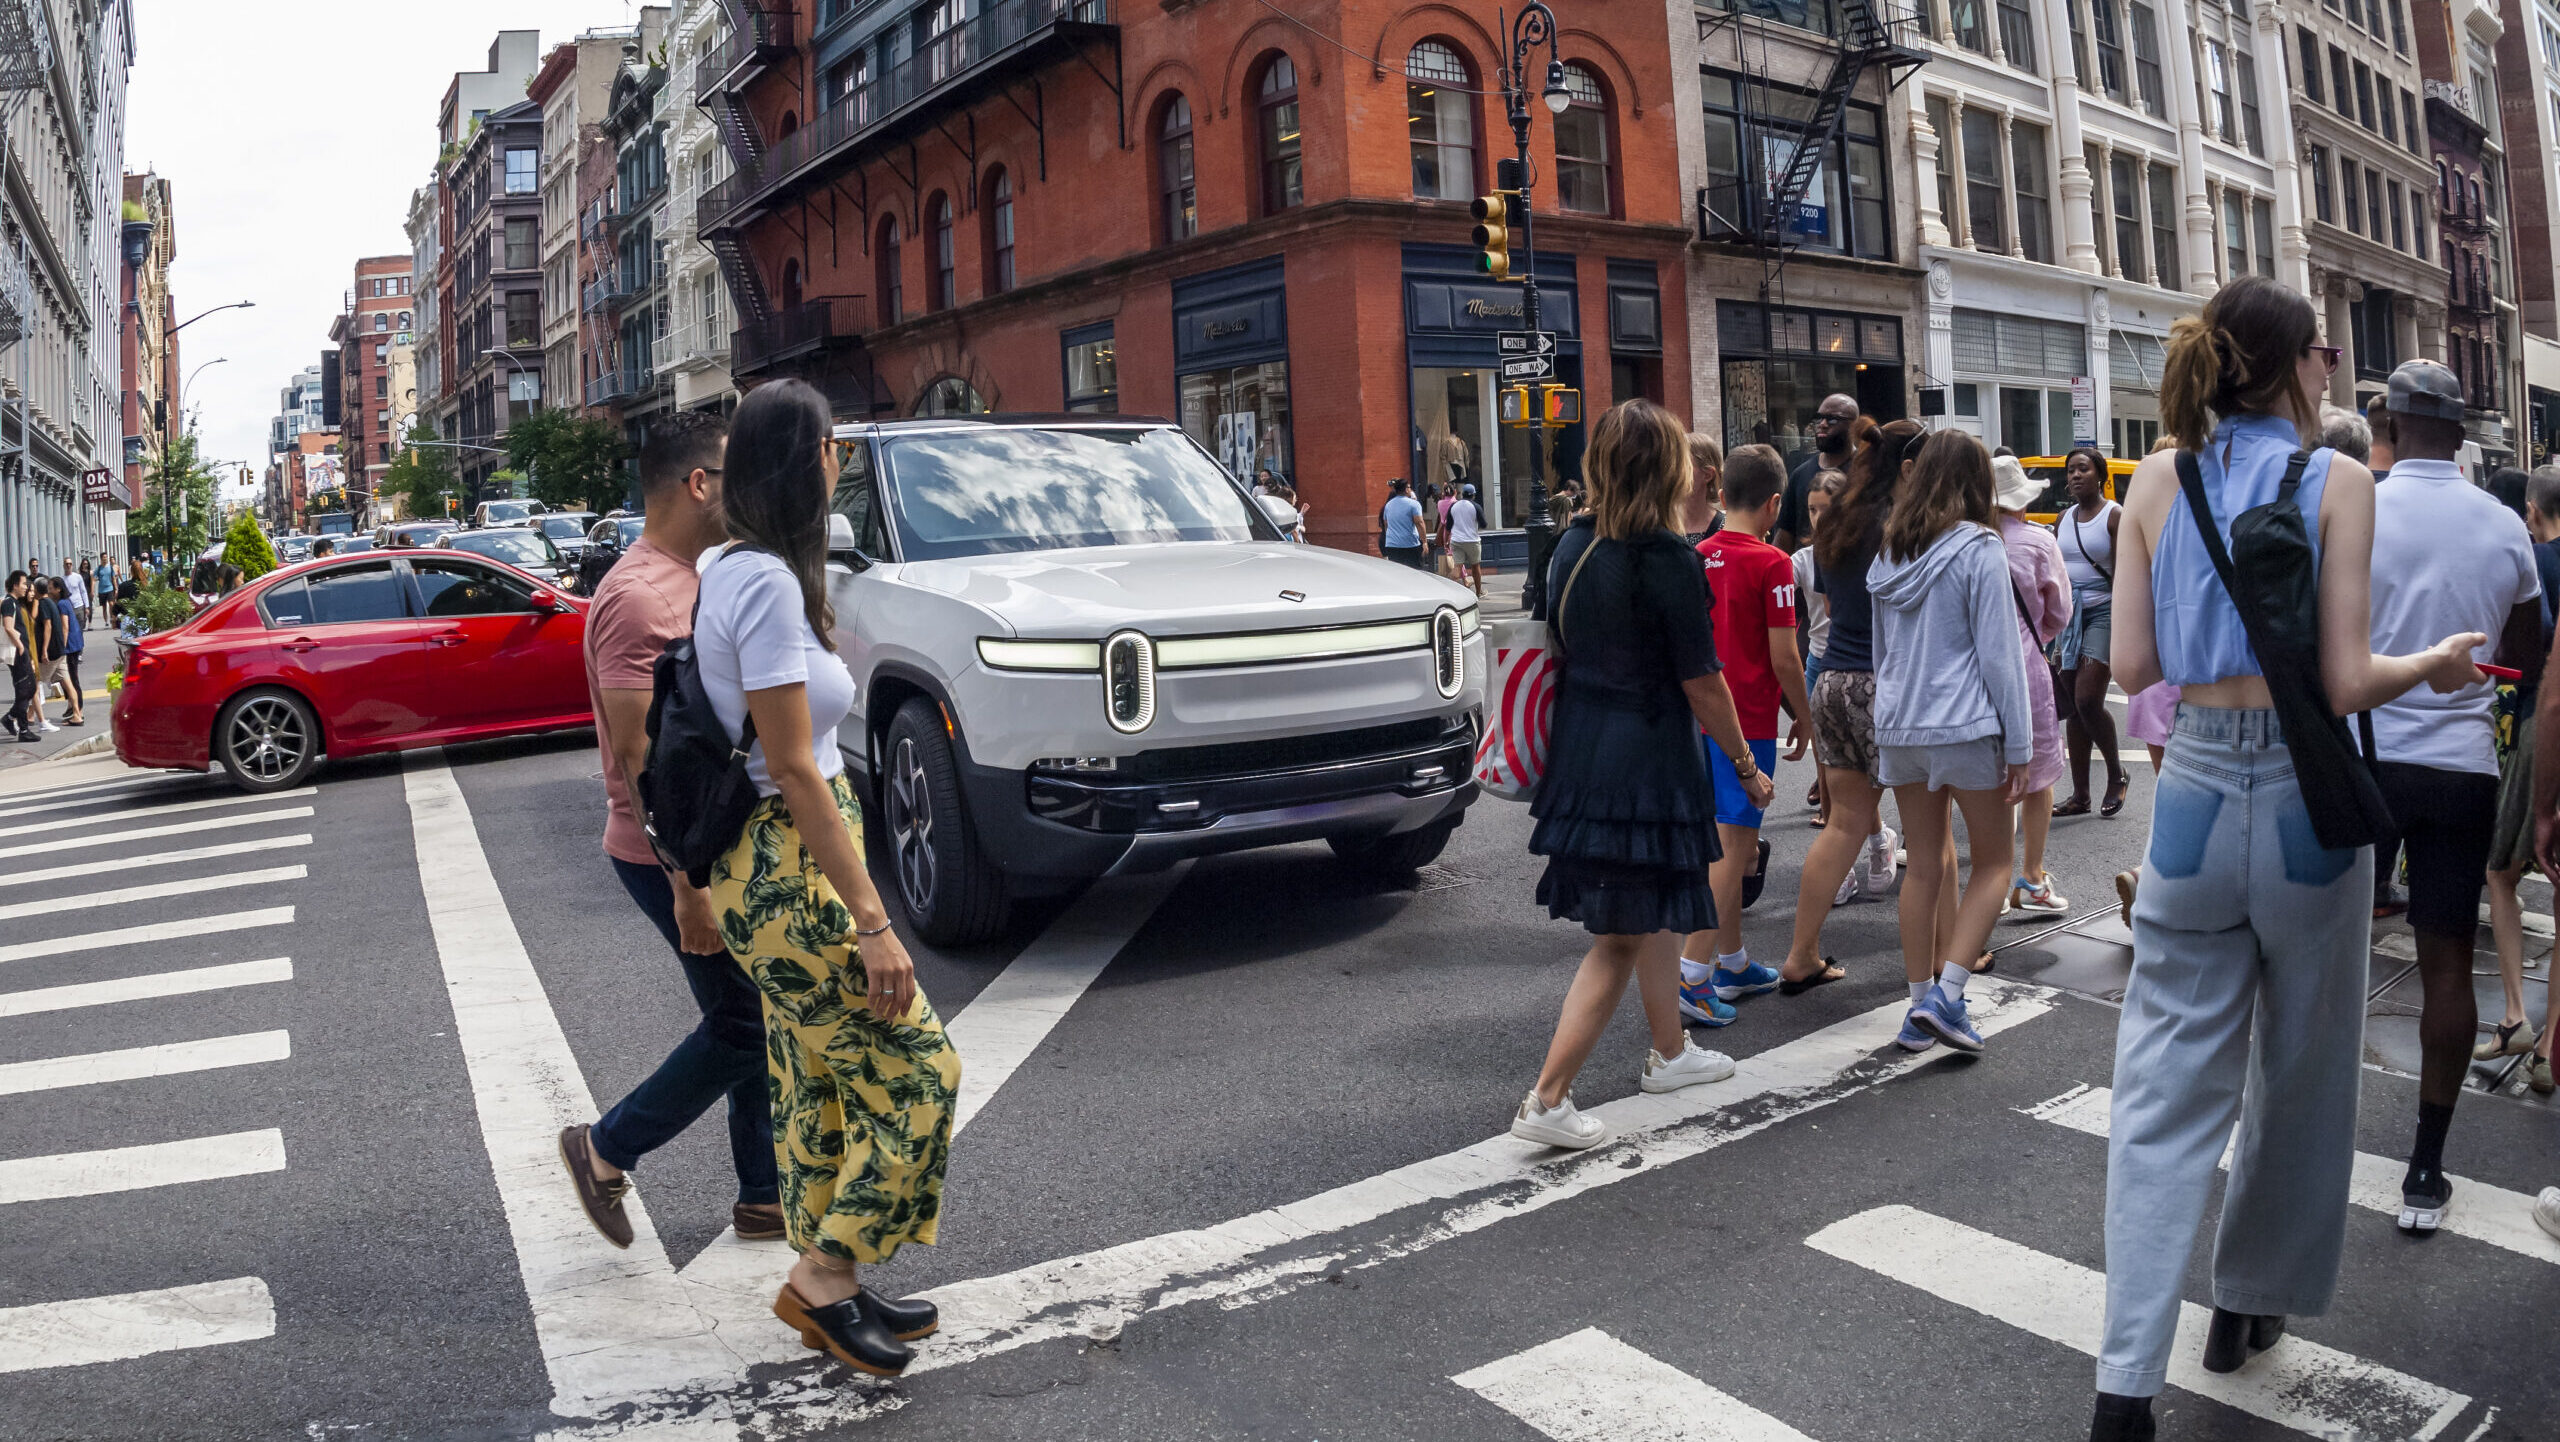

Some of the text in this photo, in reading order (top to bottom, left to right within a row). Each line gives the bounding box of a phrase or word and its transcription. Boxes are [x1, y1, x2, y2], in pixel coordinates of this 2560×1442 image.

[1801, 207, 1818, 218] 9200
[1467, 299, 1523, 318] Madewel
[1507, 339, 1523, 348] ONE
[1509, 362, 1544, 374] ONE WAY
[87, 471, 106, 485] OK
